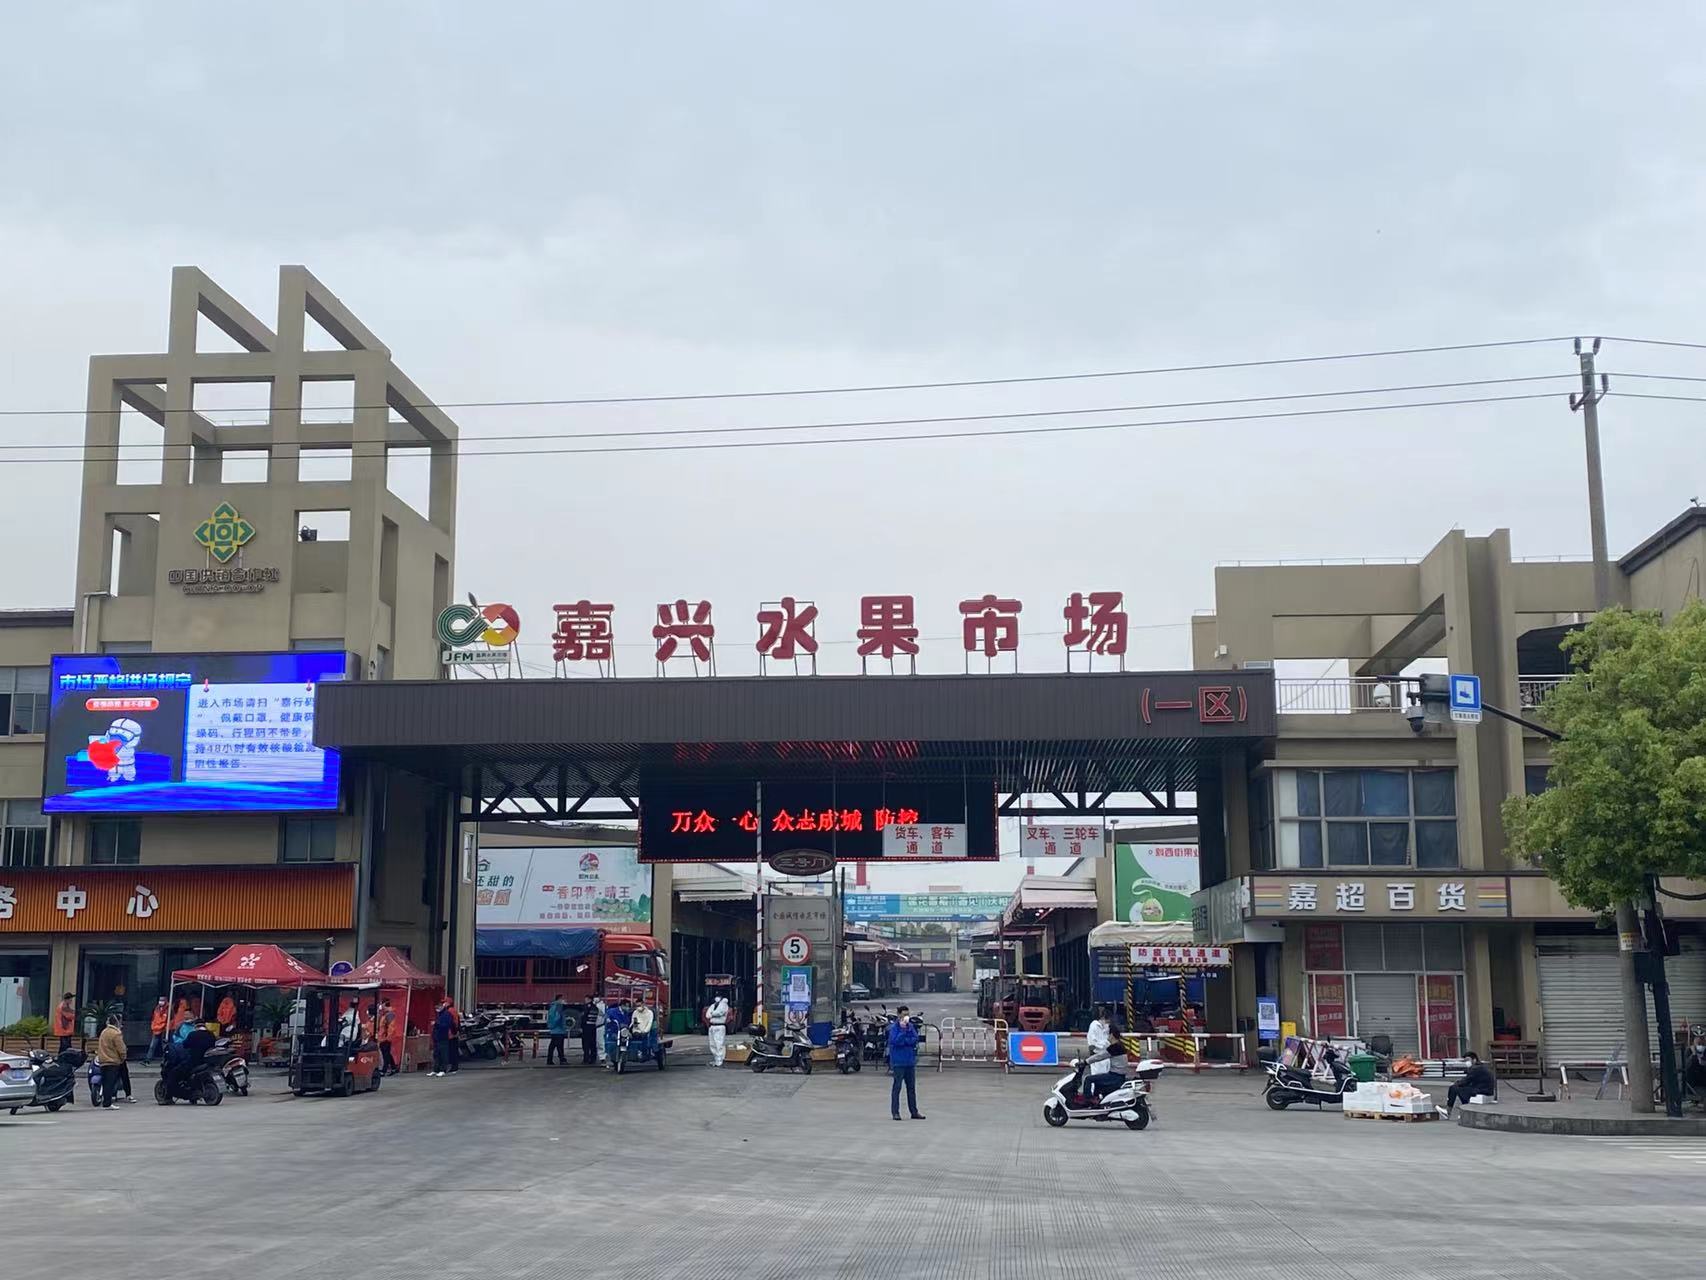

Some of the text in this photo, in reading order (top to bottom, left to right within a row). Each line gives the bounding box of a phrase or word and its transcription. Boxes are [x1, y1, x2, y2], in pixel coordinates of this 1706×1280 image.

[552, 592, 1128, 661] 嘉兴水果市场
[445, 653, 474, 661] JFM
[59, 672, 192, 690] 市场严格进场规定
[772, 808, 863, 832] 众志成城
[895, 826, 955, 840] 货车、客车
[1026, 826, 1099, 841] 叉车、三轮车
[906, 840, 943, 855] 通道
[1044, 841, 1081, 855] 通道
[1287, 881, 1467, 911] 嘉超百货
[790, 939, 801, 954] 5
[1138, 948, 1221, 957] 防疫检验通道
